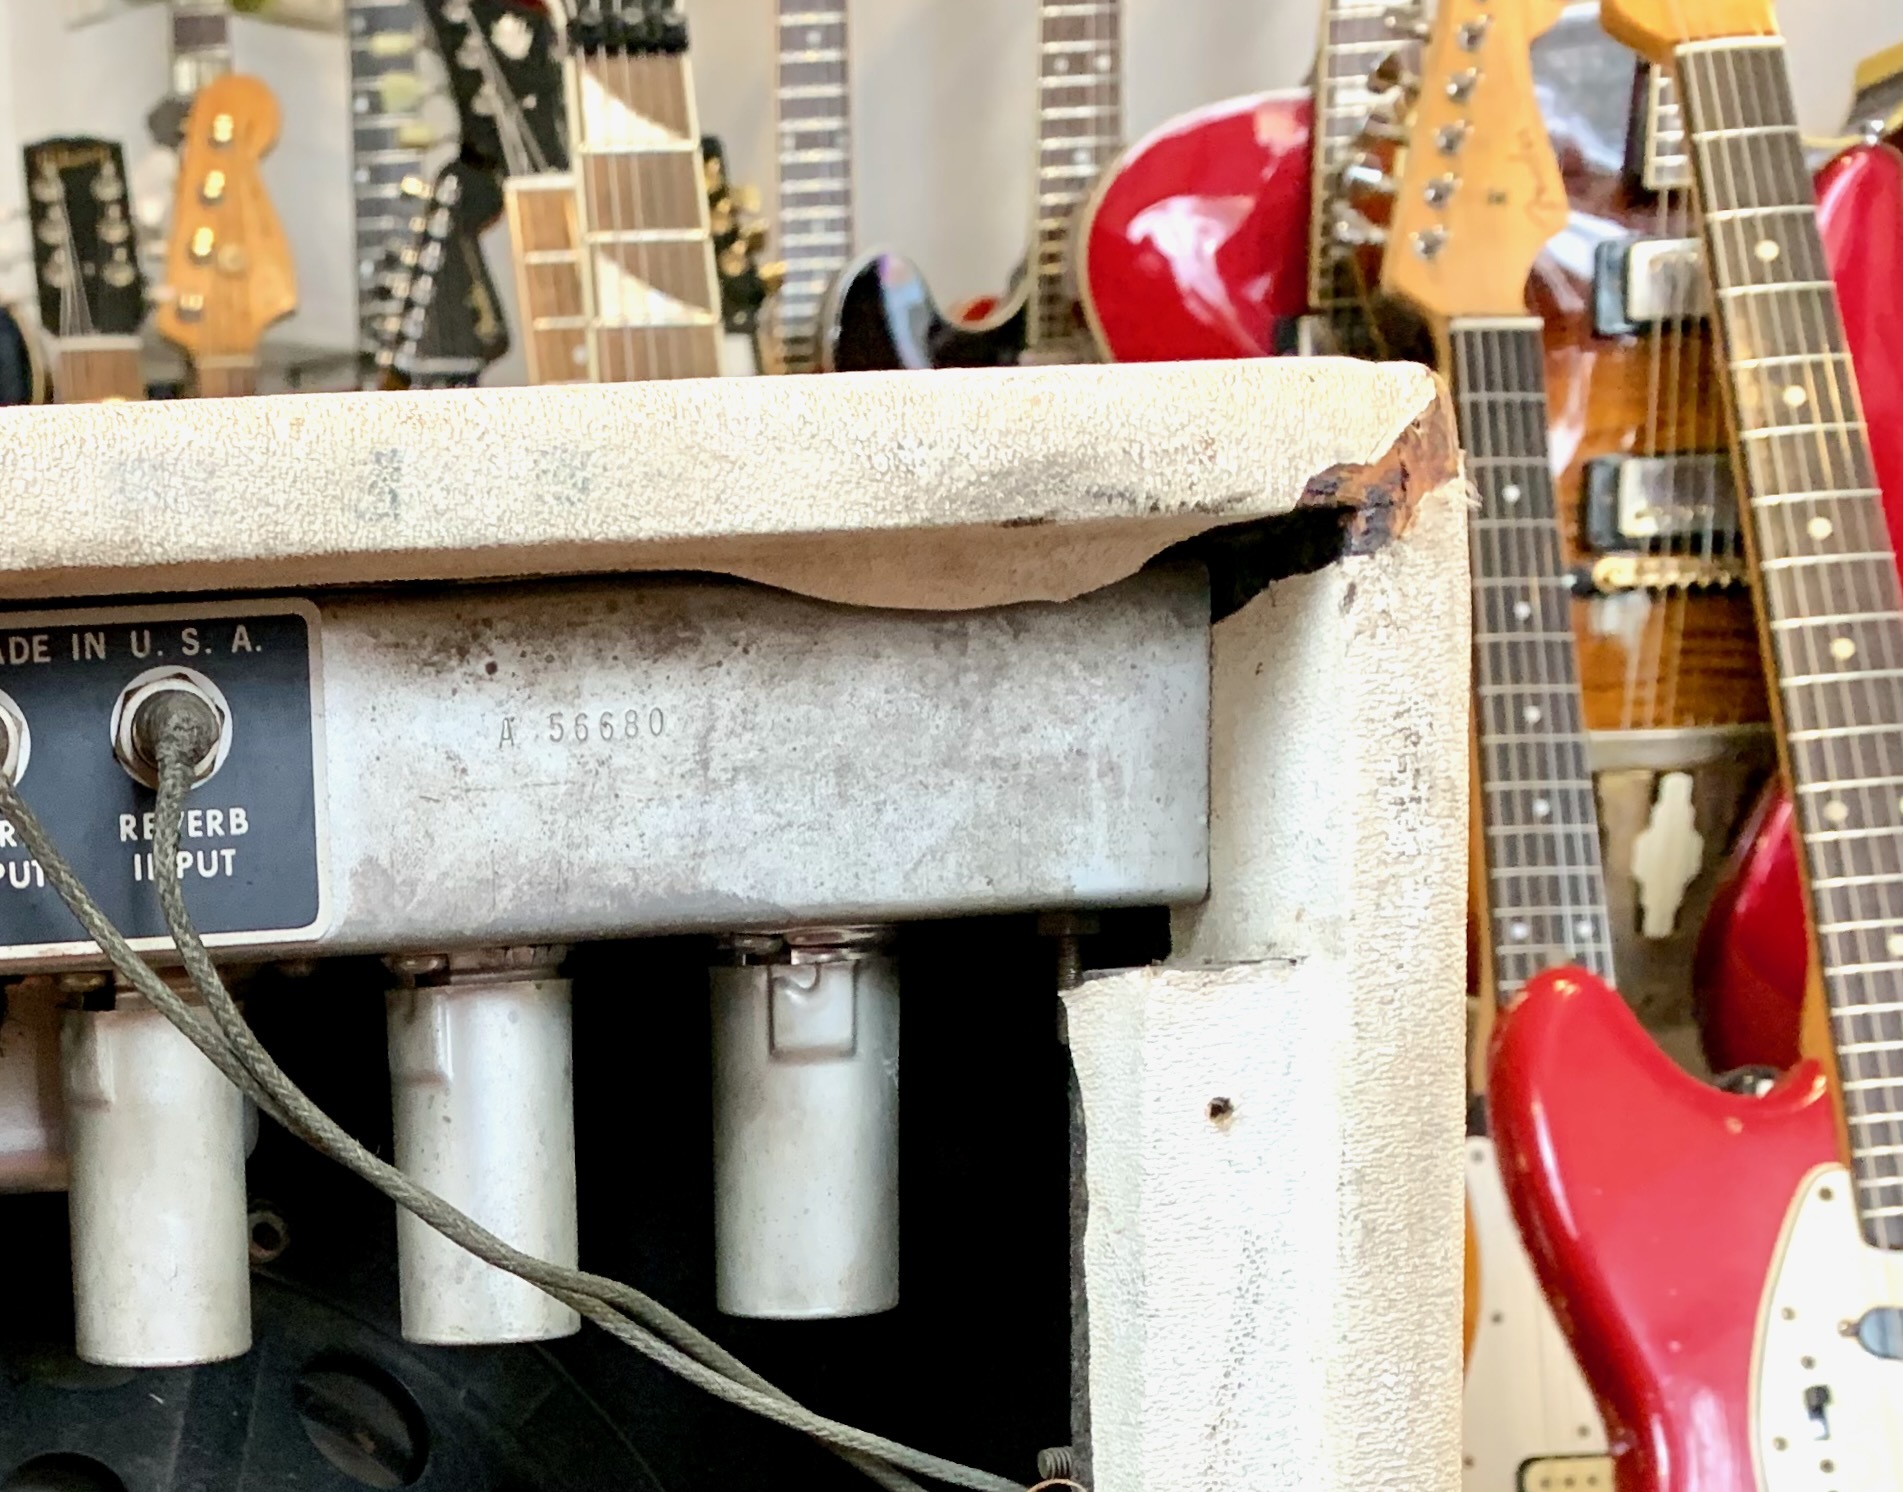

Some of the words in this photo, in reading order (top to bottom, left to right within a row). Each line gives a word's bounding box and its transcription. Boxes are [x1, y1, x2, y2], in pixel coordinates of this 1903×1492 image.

[71, 631, 107, 662] IN
[548, 706, 664, 743] 56680
[119, 806, 250, 843] REERB
